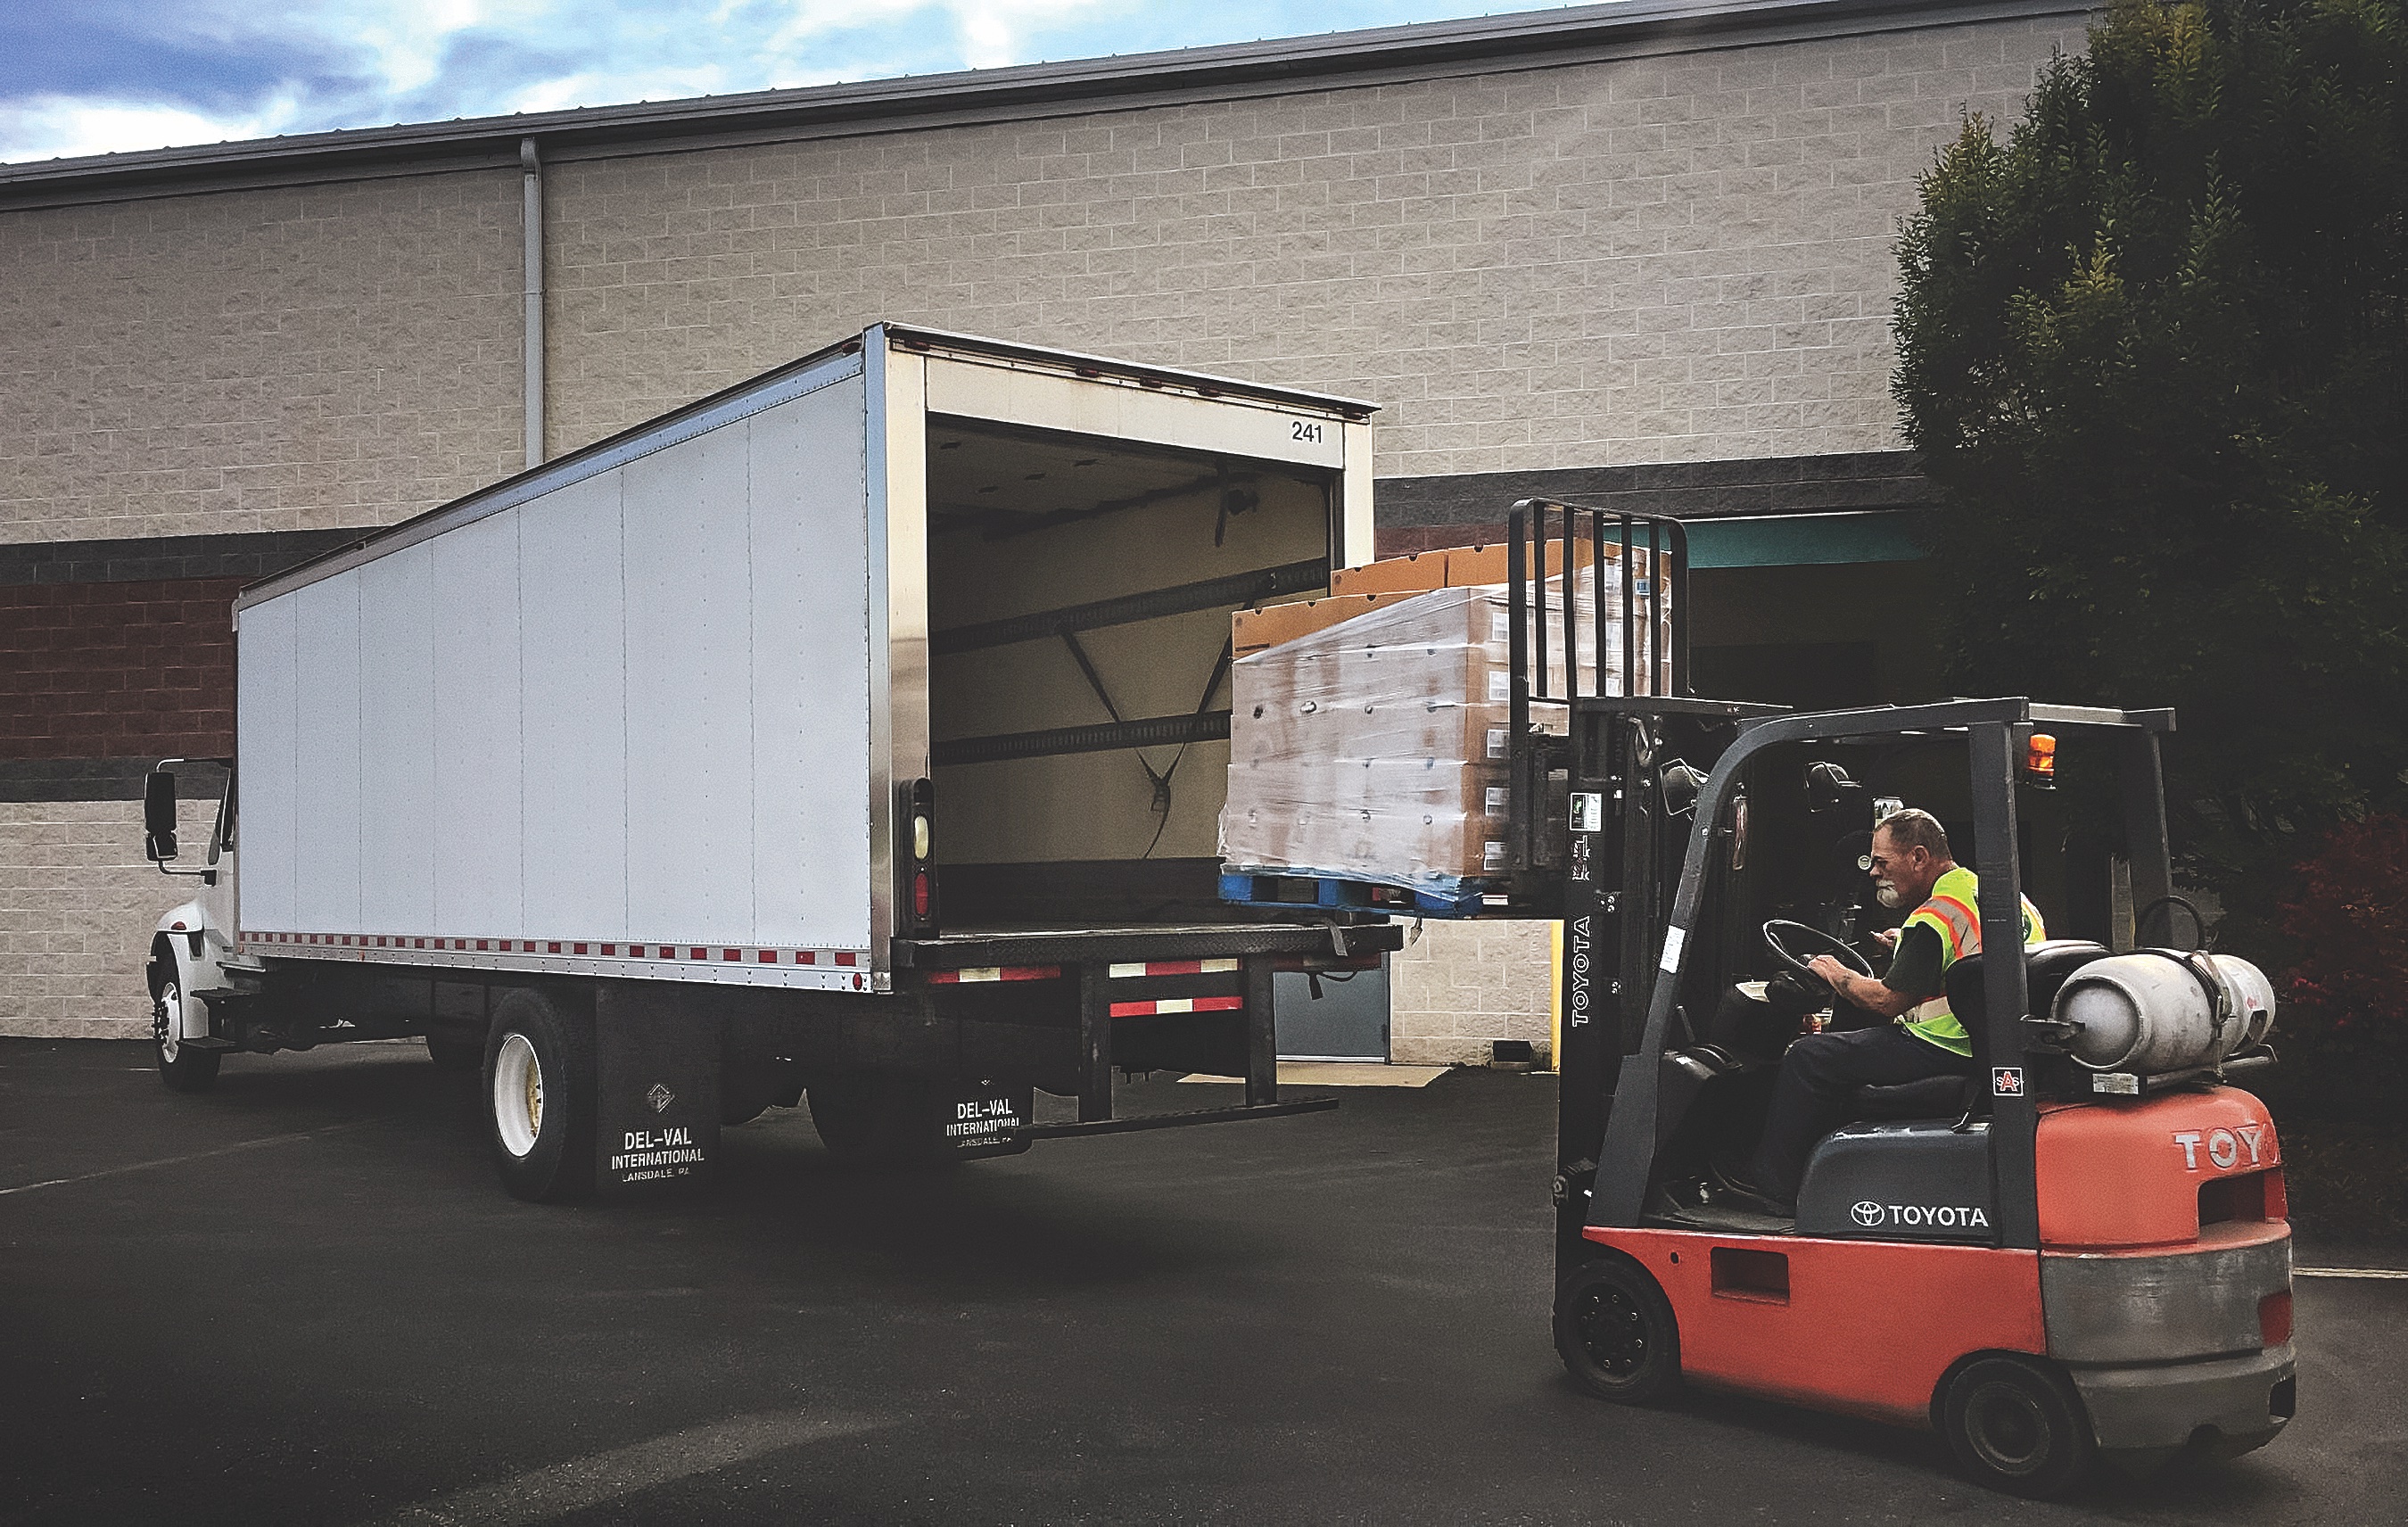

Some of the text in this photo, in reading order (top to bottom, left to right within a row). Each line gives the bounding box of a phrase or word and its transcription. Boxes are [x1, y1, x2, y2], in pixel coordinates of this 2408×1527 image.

[1291, 421, 1322, 444] 241
[1571, 915, 1590, 1028] TOYOTA
[957, 1098, 1013, 1119] DEL-VAL
[624, 1127, 692, 1151] DEL-VAL
[611, 1148, 705, 1170] INTERNATIONAL
[1888, 1205, 1989, 1227] TOYOTA
